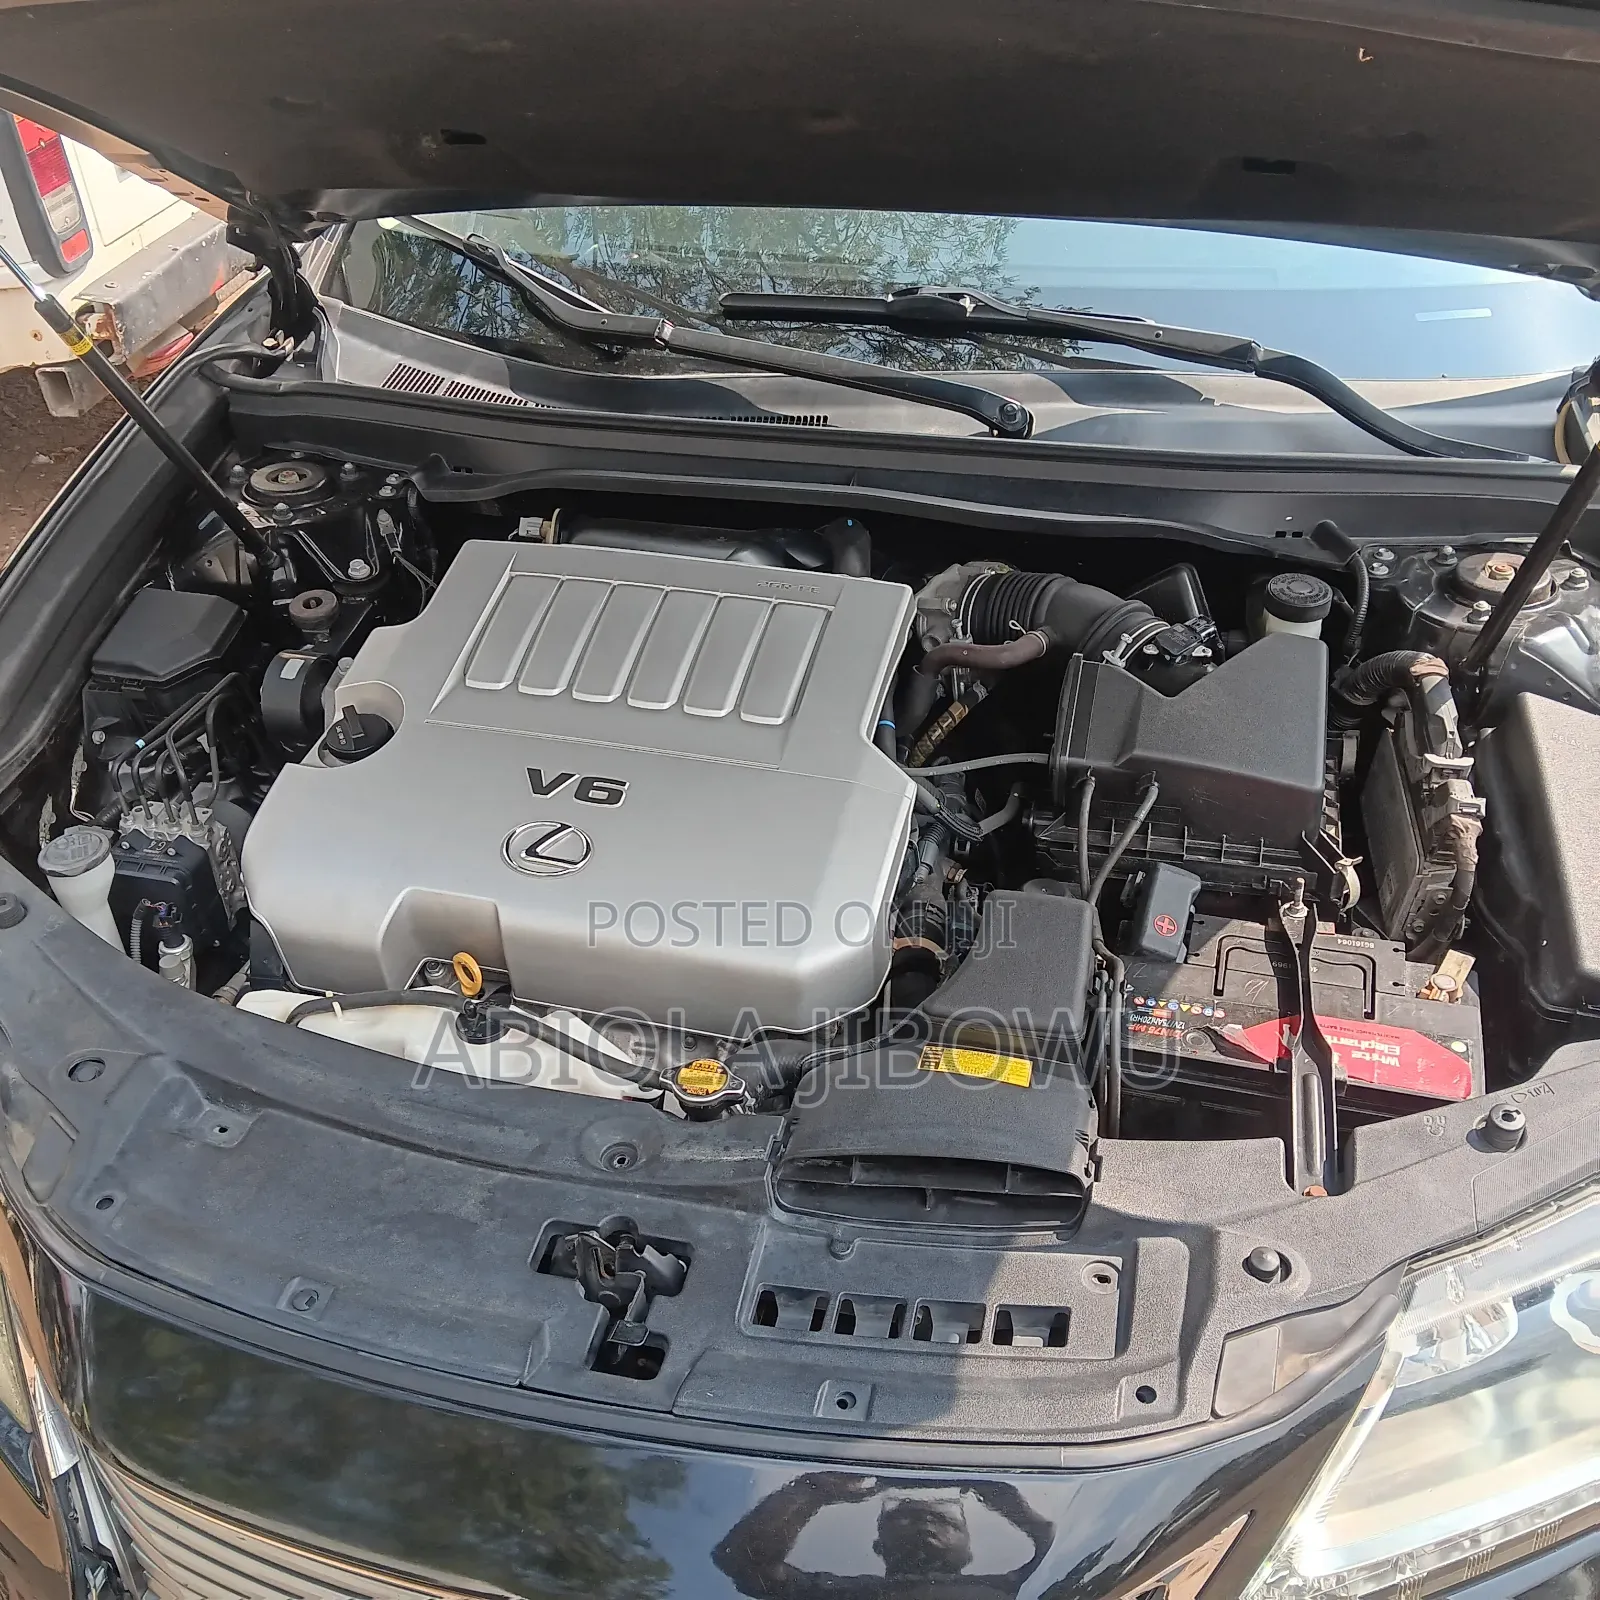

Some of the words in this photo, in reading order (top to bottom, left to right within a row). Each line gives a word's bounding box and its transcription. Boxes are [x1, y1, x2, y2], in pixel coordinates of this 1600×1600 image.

[525, 766, 630, 809] V6
[1323, 1034, 1401, 1056] Elephant
[1351, 1050, 1401, 1067] White
